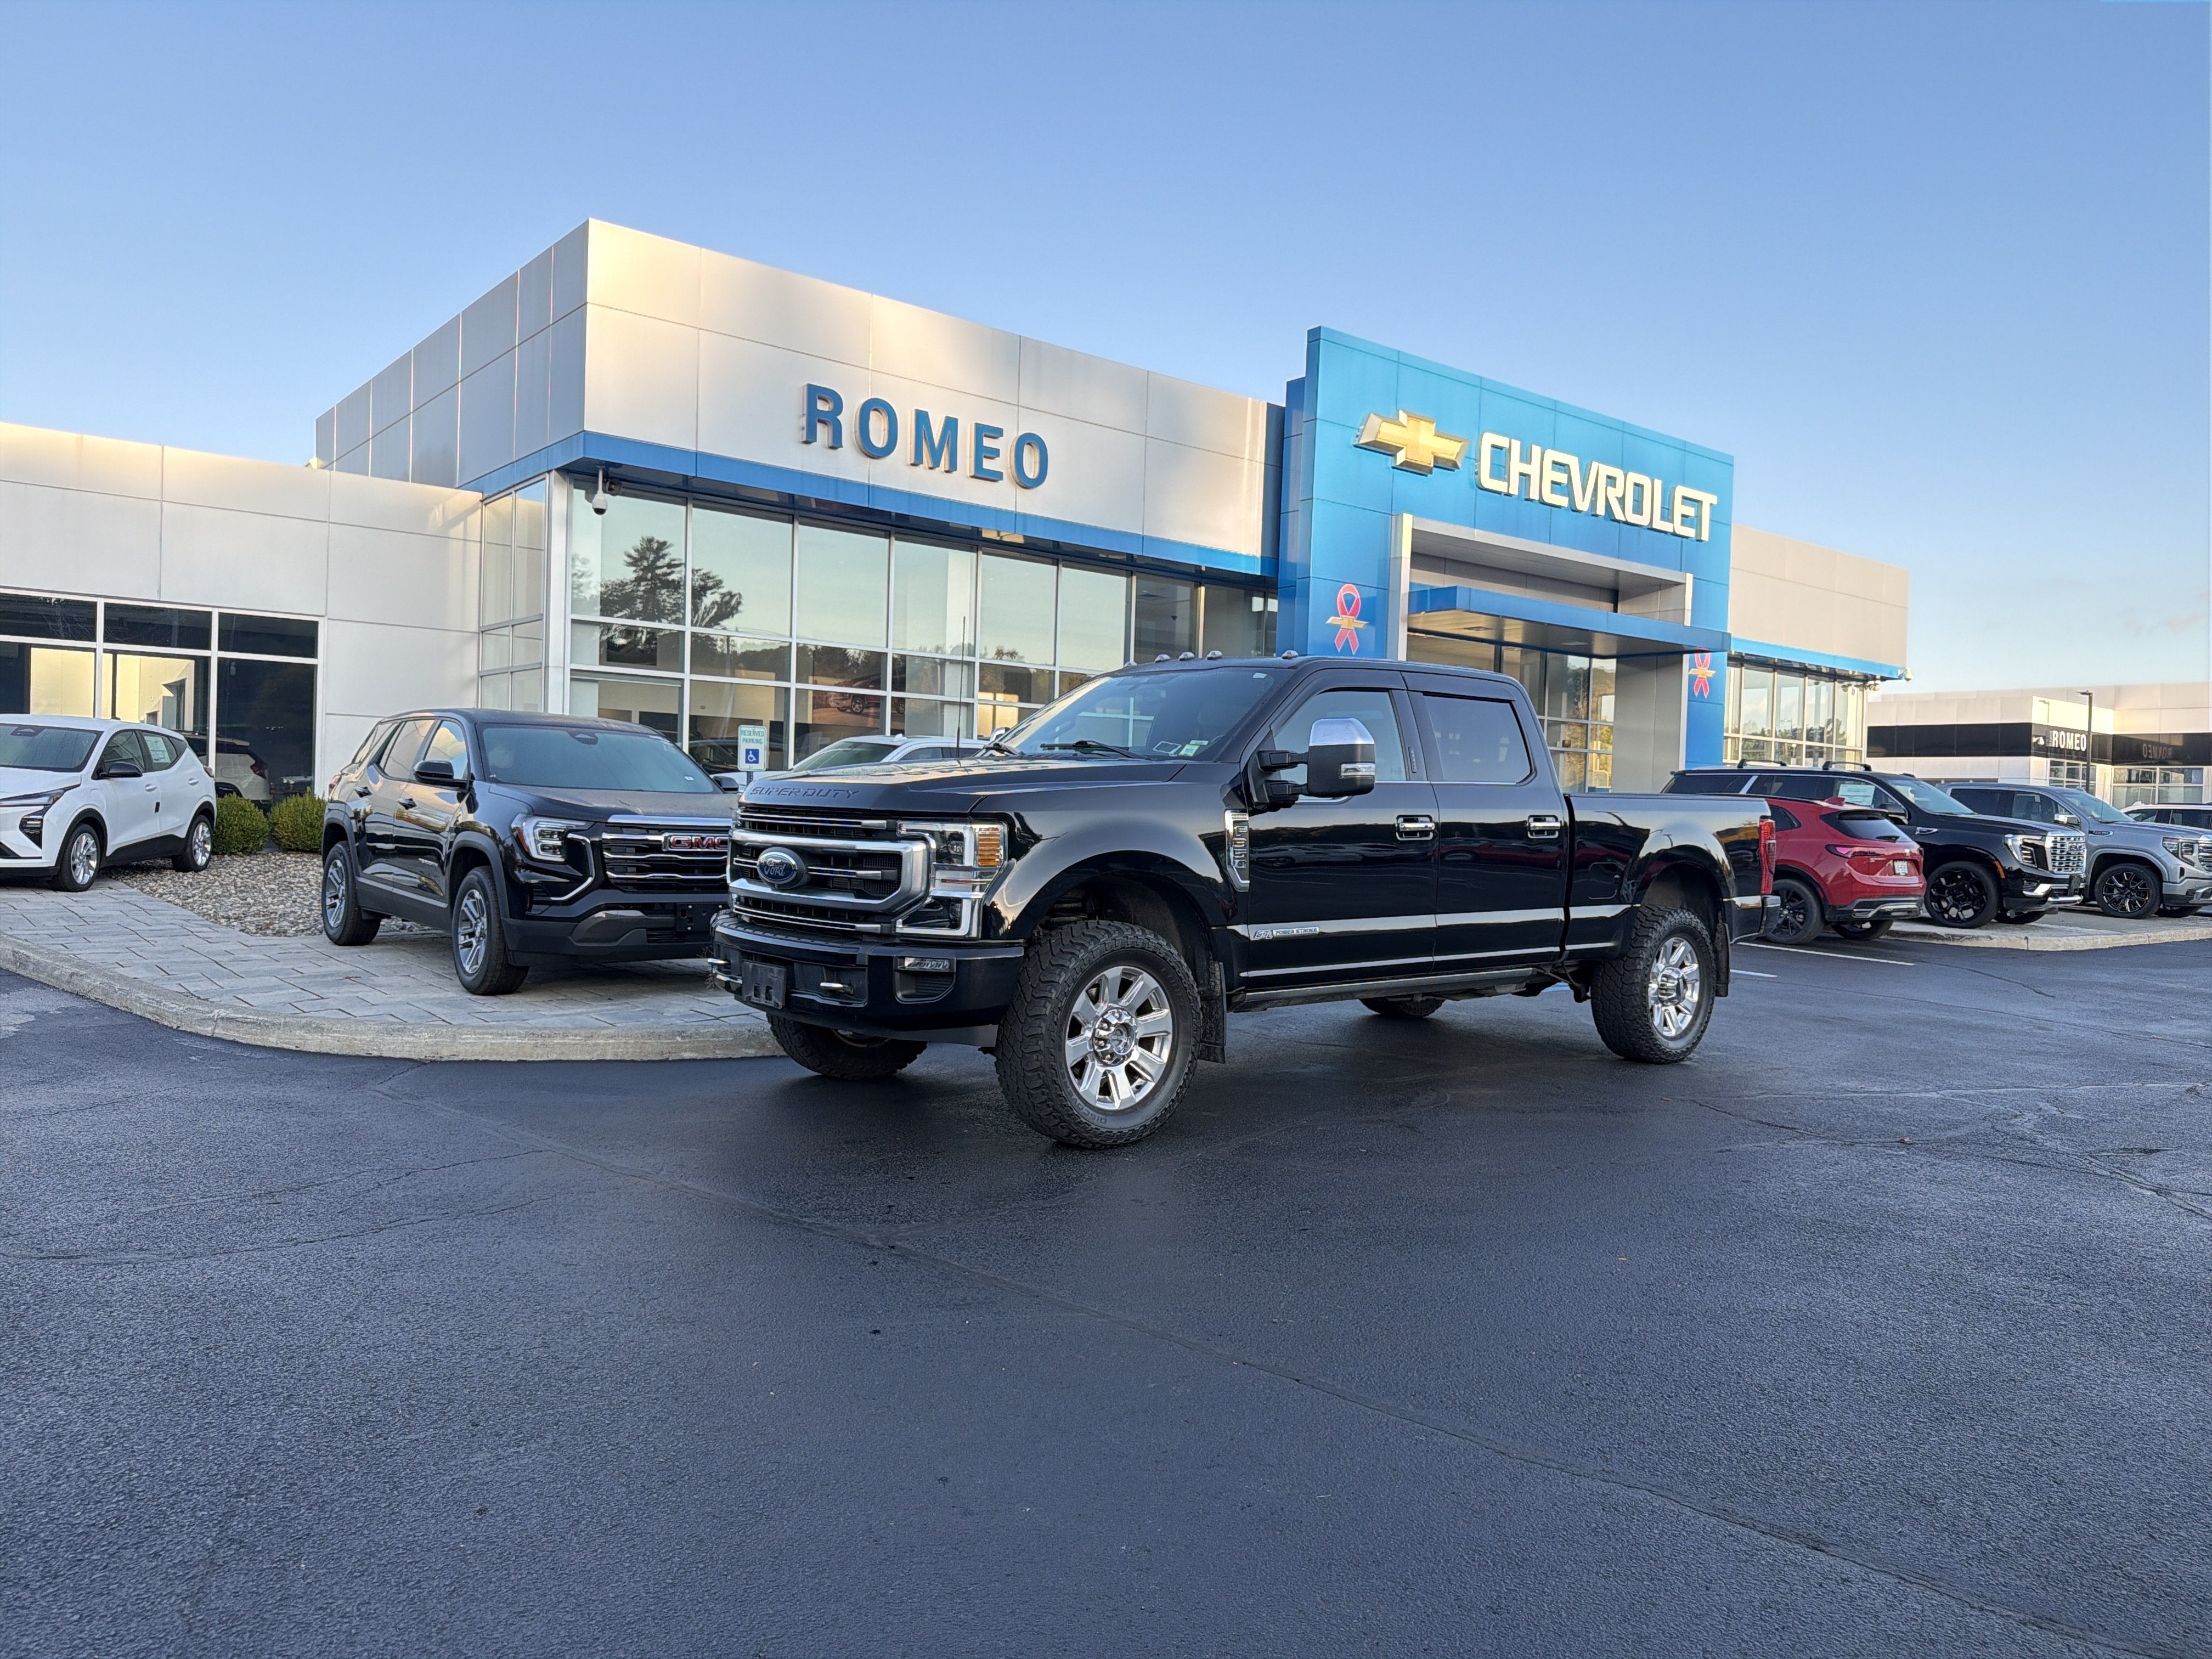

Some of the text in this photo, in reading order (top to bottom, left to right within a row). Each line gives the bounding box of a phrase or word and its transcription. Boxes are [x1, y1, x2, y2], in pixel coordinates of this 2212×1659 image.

[803, 383, 1048, 489] ROMEO
[1480, 432, 1718, 541] CHEVROLET
[2052, 730, 2086, 752] ROMEO
[750, 787, 860, 799] SUPER DUTY
[764, 857, 786, 877] Ford
